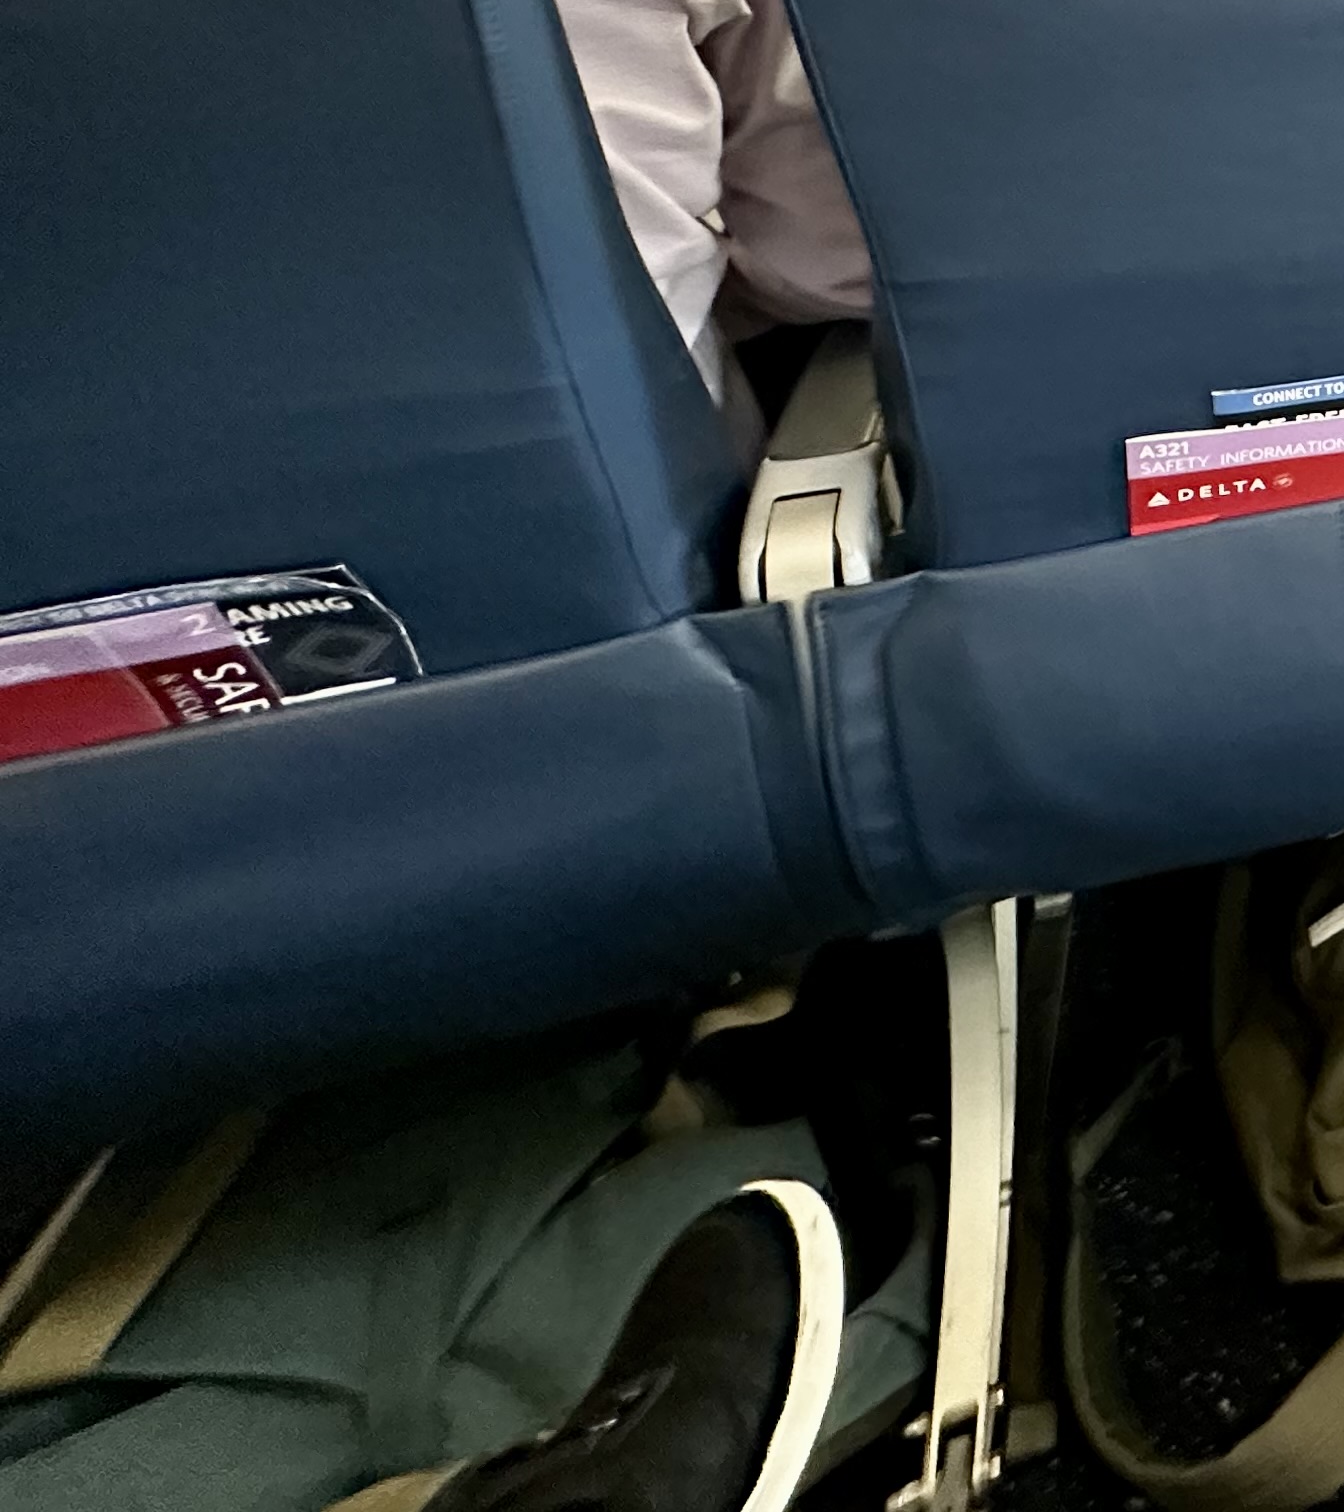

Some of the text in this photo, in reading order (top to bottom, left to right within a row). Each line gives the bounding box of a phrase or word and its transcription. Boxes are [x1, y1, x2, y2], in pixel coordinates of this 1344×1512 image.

[1253, 383, 1323, 406] CONNECT
[1324, 381, 1344, 396] TO
[1139, 441, 1190, 459] A321
[1139, 455, 1210, 476] SAFETY
[1178, 477, 1267, 502] DELTA
[181, 613, 216, 637] 2
